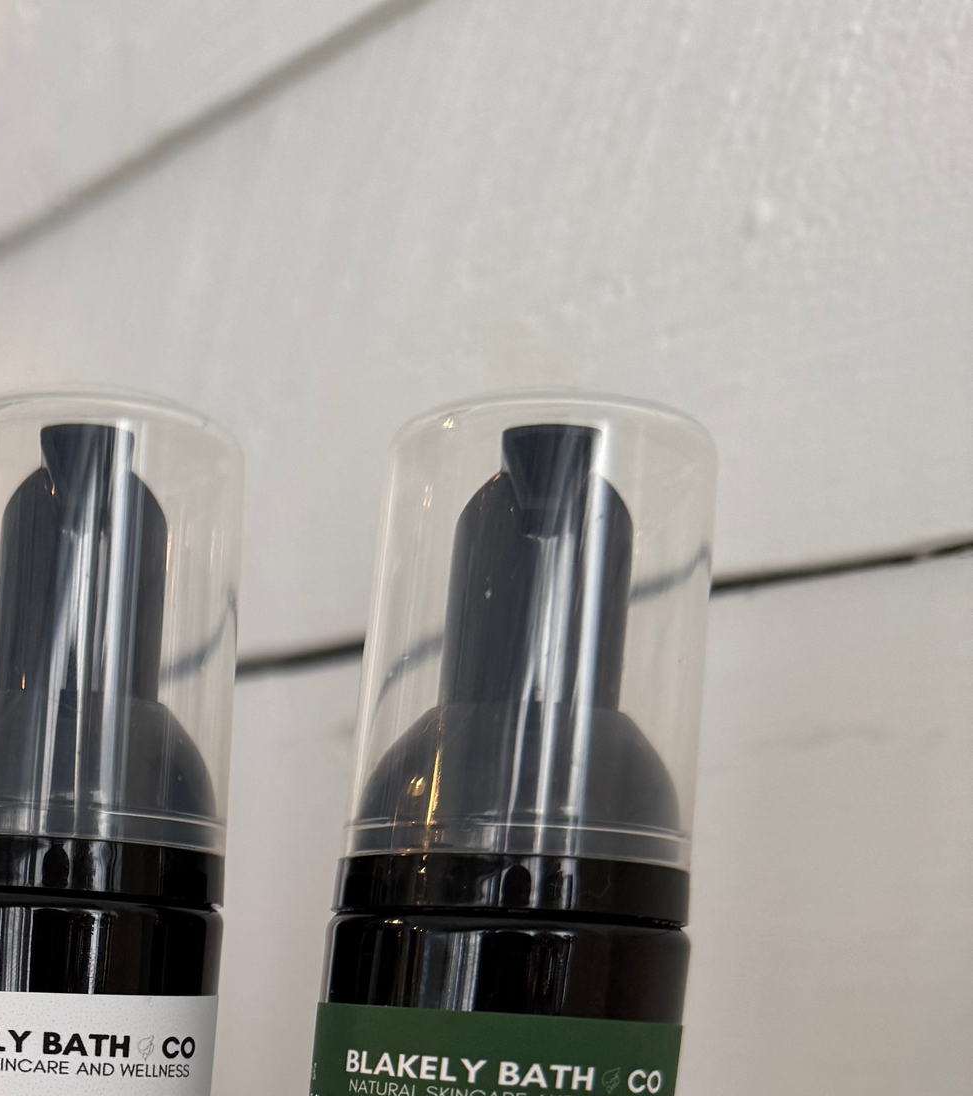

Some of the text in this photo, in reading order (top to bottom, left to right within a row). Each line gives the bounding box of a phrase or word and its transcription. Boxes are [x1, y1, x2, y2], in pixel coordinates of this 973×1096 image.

[42, 1031, 130, 1058] BATH
[161, 1036, 195, 1060] CO
[76, 1062, 115, 1077] AND
[120, 1063, 190, 1079] WELLNESS
[345, 1049, 487, 1085] BLAKELY
[498, 1062, 595, 1091] BATH
[627, 1068, 662, 1094] CO
